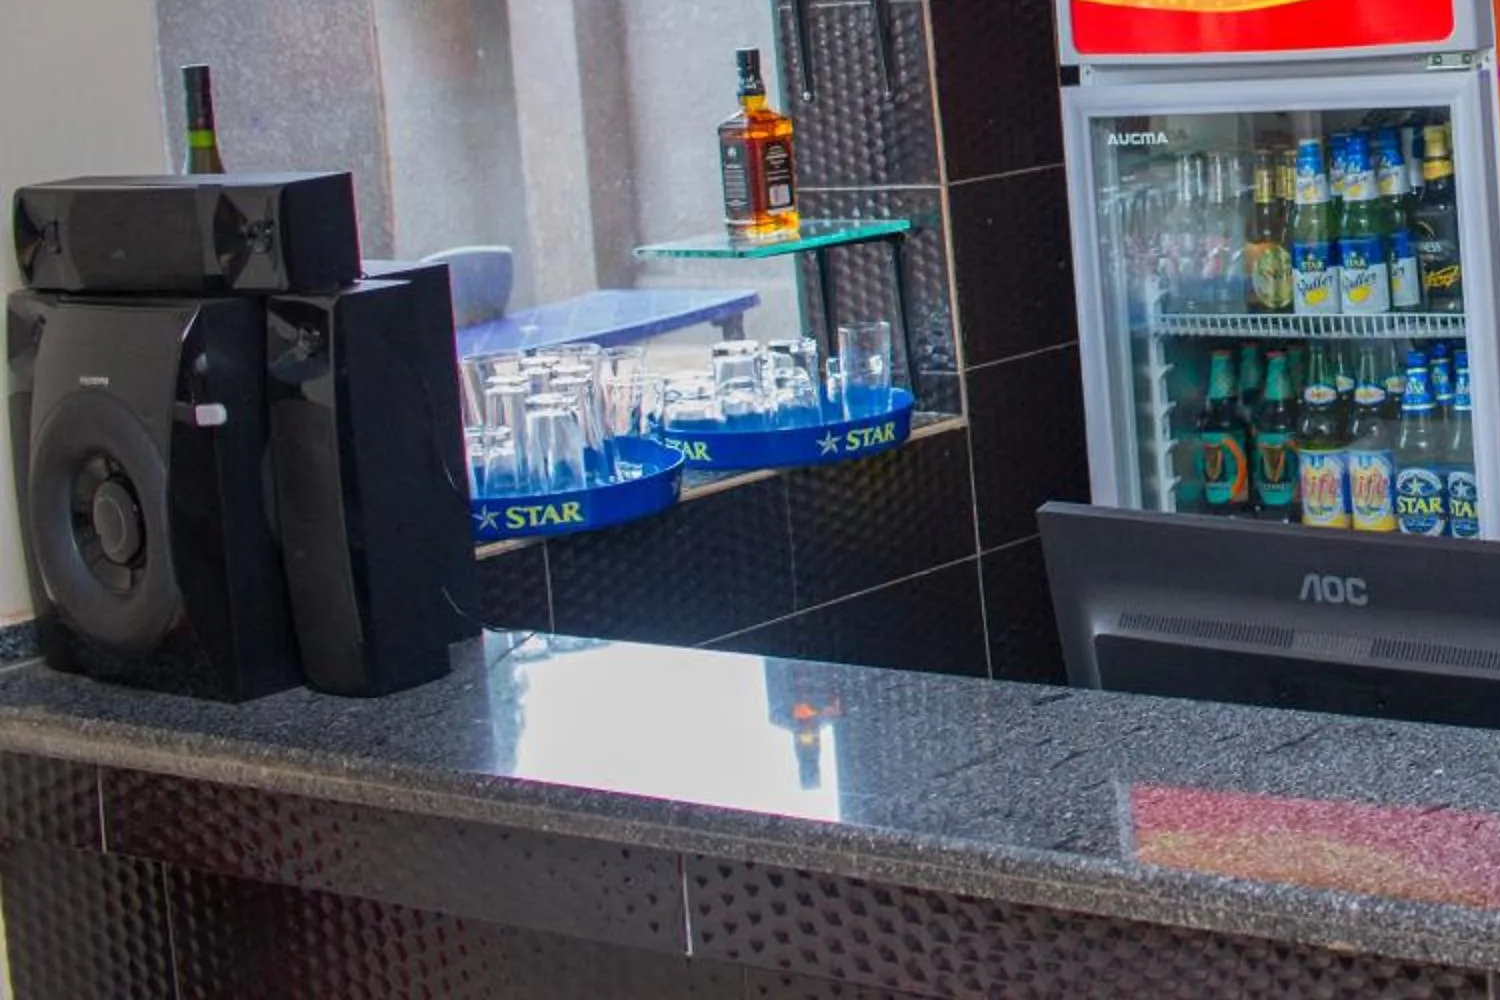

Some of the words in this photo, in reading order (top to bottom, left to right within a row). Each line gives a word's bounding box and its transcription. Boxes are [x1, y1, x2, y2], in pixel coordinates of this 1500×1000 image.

[1107, 131, 1169, 146] AUCMA
[846, 422, 897, 451] STAR
[505, 500, 585, 529] STAR
[1397, 496, 1444, 513] STAR
[1451, 499, 1476, 517] STA
[1300, 573, 1368, 606] AOC
